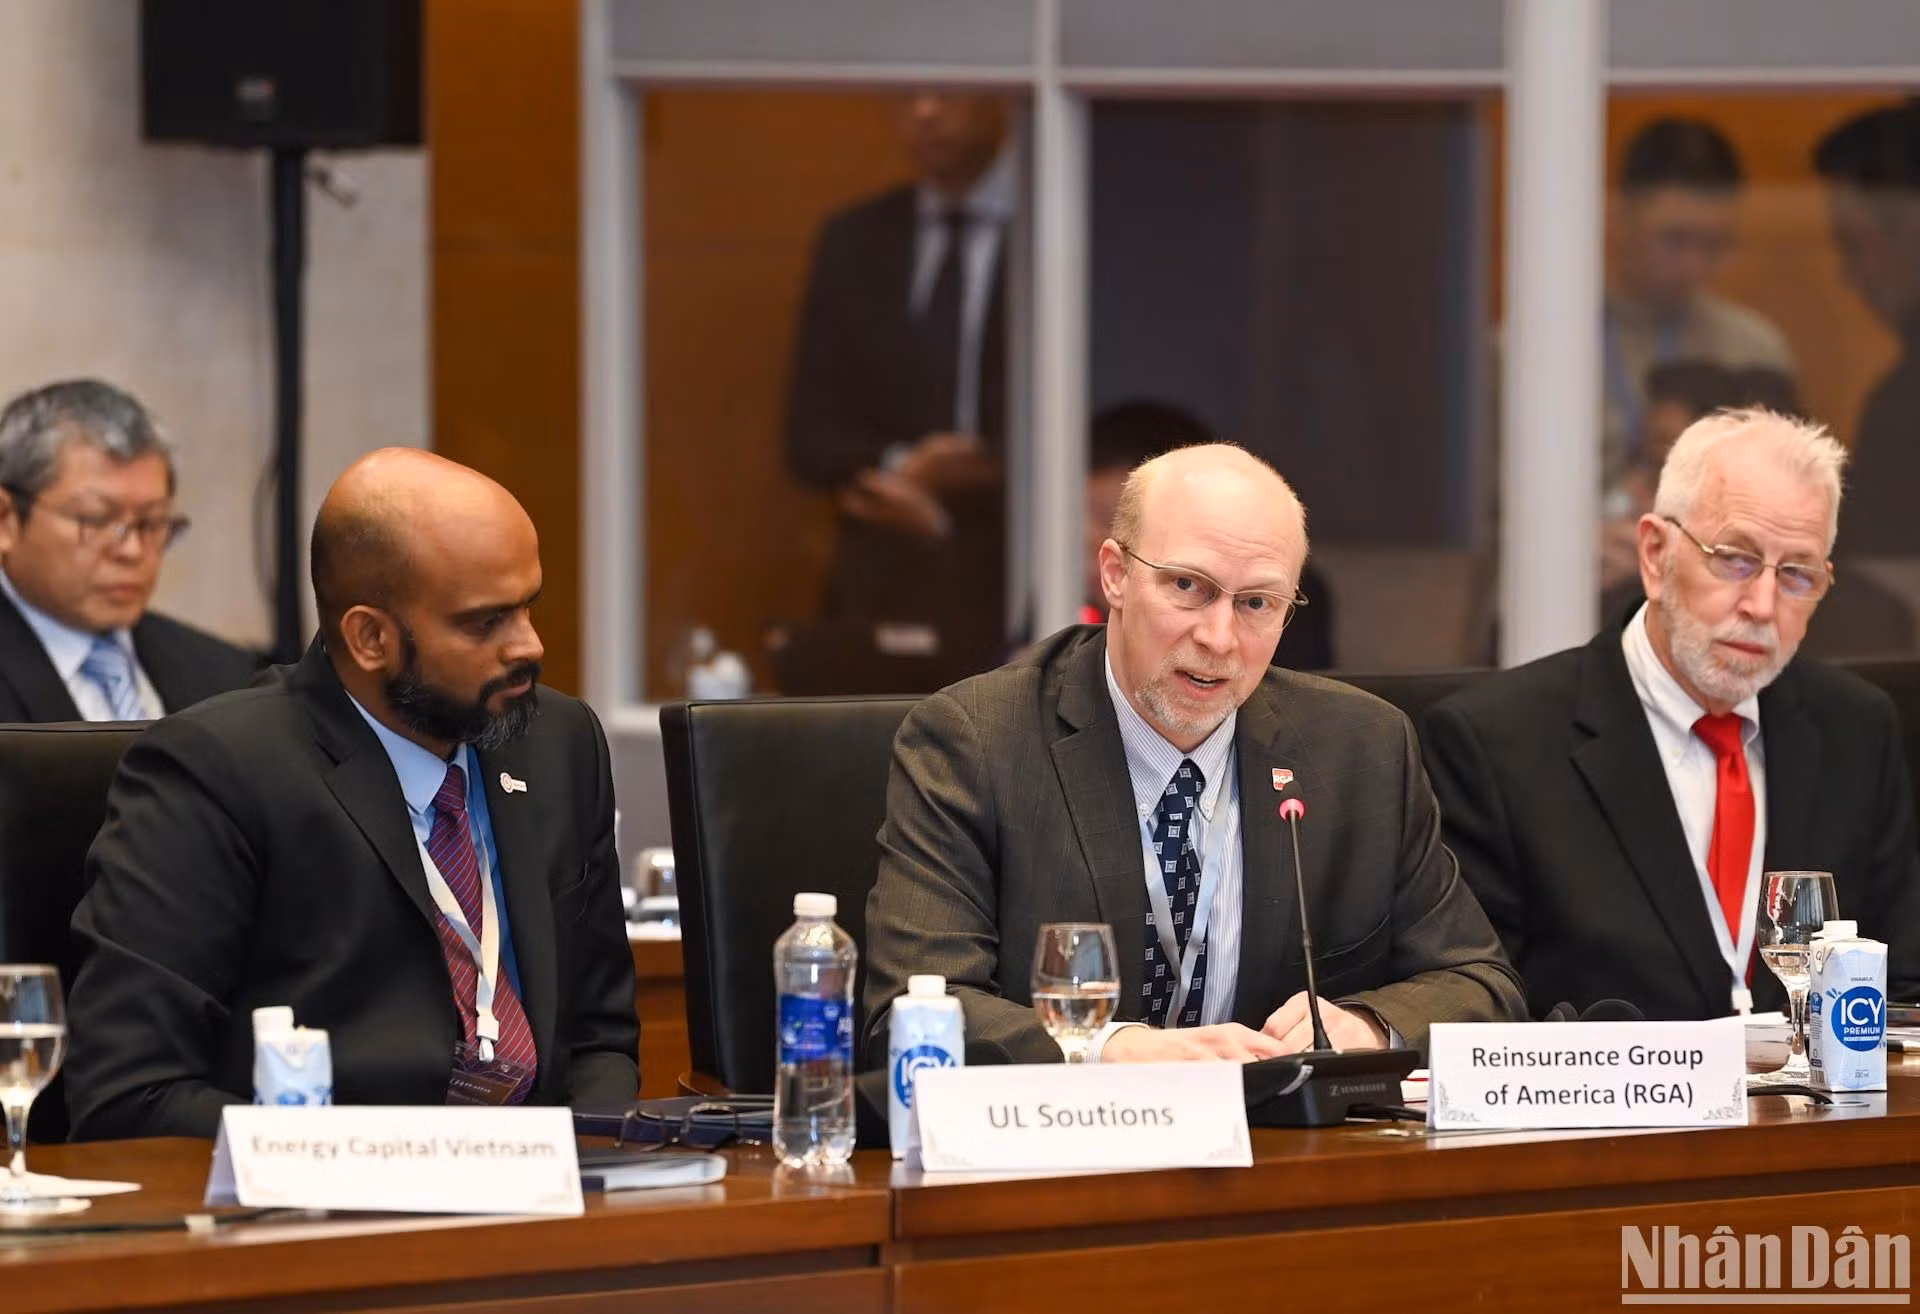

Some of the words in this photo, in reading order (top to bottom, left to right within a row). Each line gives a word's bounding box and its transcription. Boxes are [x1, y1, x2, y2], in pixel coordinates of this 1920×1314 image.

[1840, 997, 1884, 1026] ICY
[1843, 1026, 1881, 1036] PREMIUM
[1472, 1046, 1620, 1068] Reinsurance
[1627, 1045, 1704, 1070] Group
[1484, 1084, 1509, 1106] of
[1516, 1083, 1616, 1105] America
[1624, 1081, 1693, 1109] (RGA)
[988, 1104, 1029, 1129] UL
[1037, 1102, 1174, 1128] Soutions
[250, 1135, 338, 1160] Energy
[349, 1136, 438, 1160] Capital
[445, 1138, 556, 1158] Vietnam
